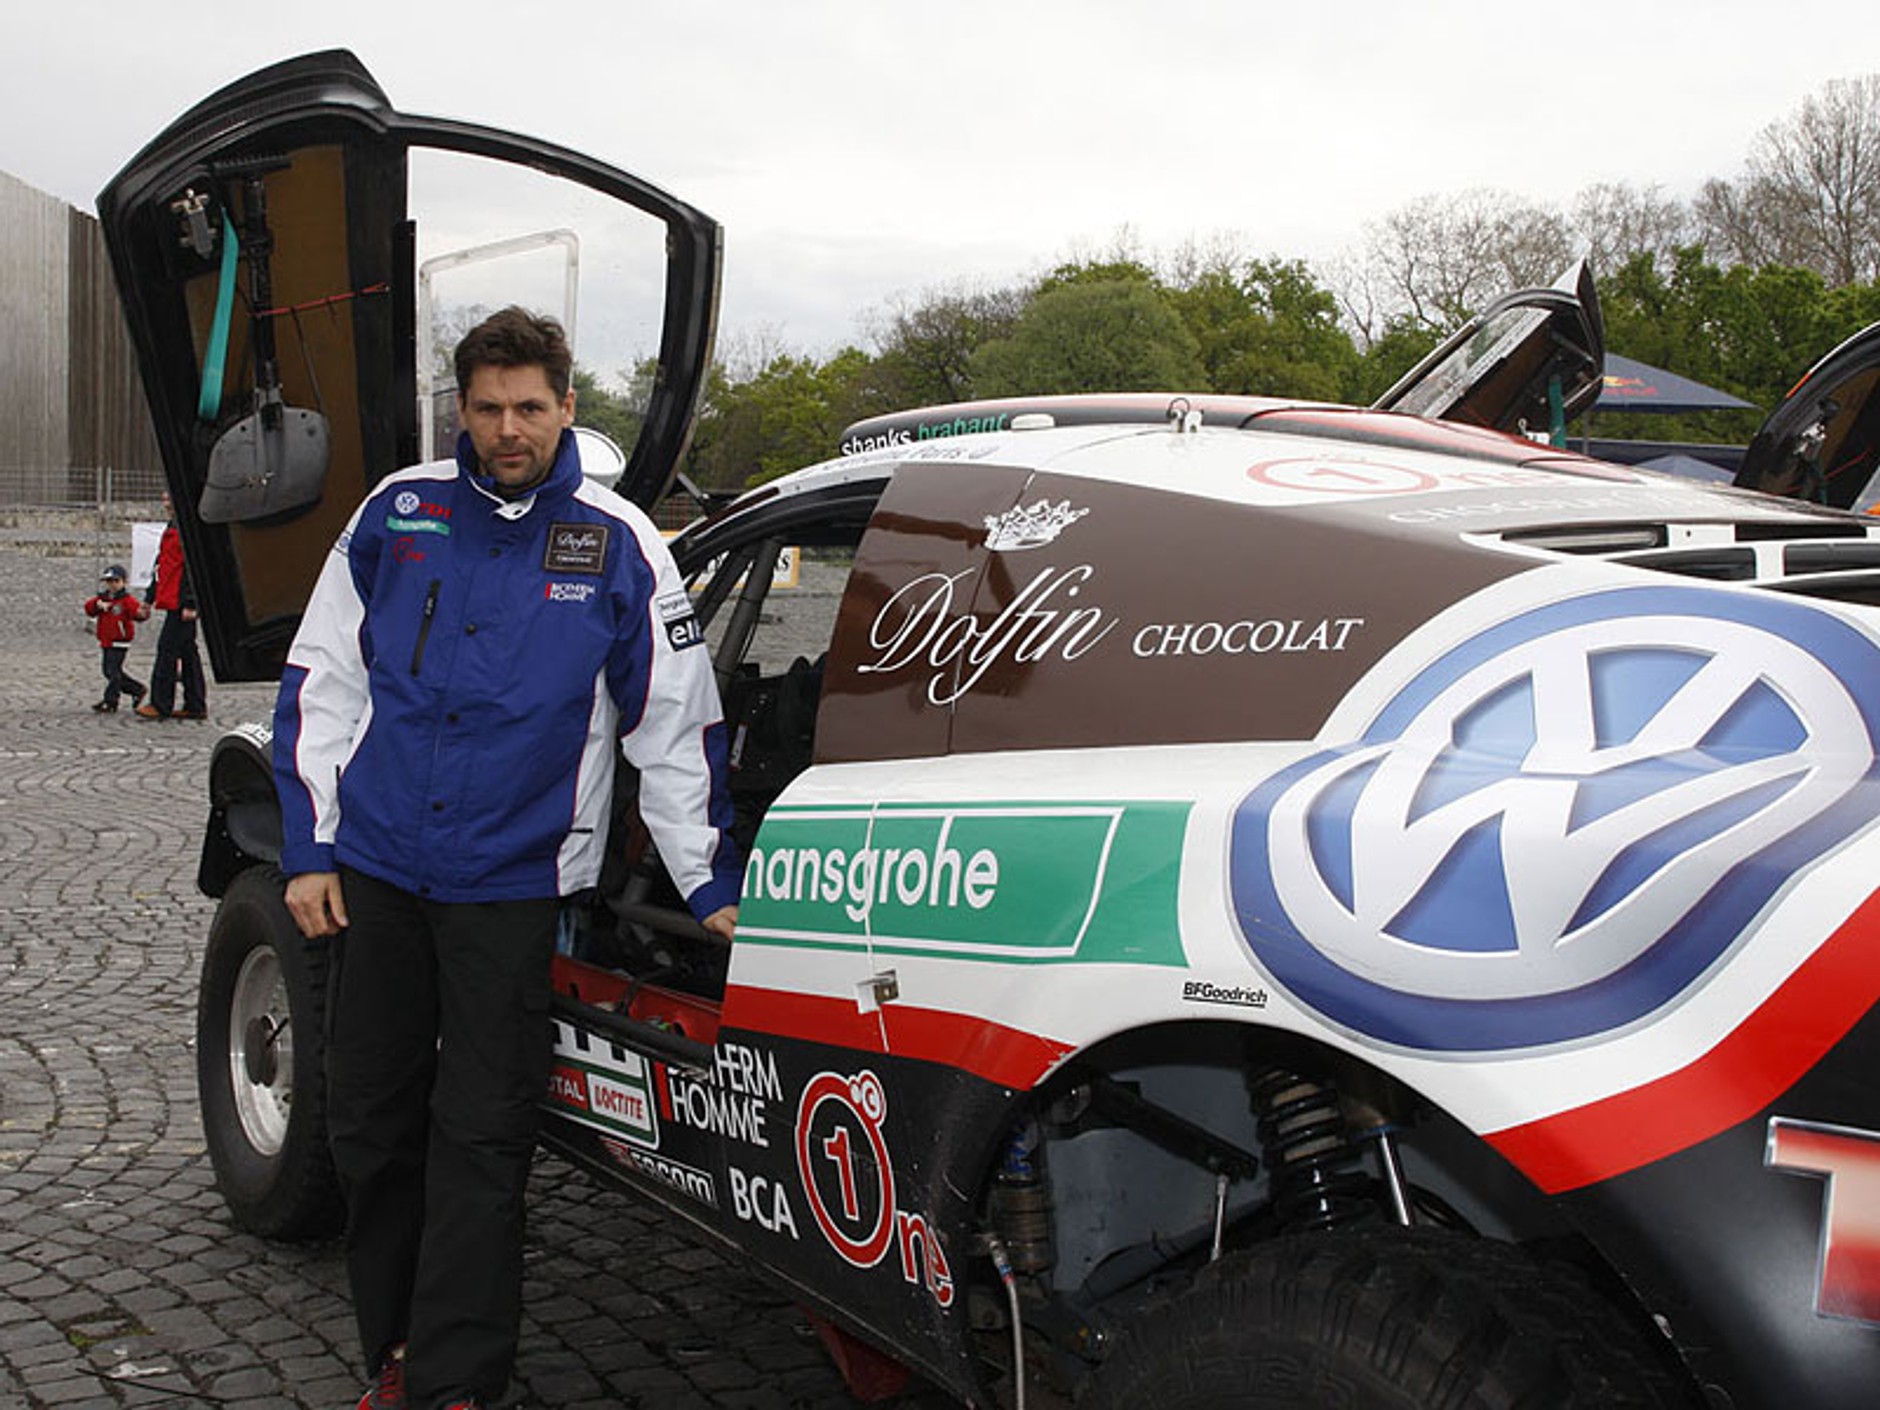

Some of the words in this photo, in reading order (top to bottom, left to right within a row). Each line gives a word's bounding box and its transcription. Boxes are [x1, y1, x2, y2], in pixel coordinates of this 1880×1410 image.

[840, 427, 912, 457] shanks
[857, 563, 1120, 705] Dolfin
[1132, 617, 1365, 658] CHOCOLAT
[741, 816, 999, 922] hansgrohe
[1183, 981, 1268, 1004] BFGoodrich
[594, 1083, 644, 1121] LOCTITE
[669, 1076, 769, 1148] HOMME
[729, 1166, 799, 1240] BCA
